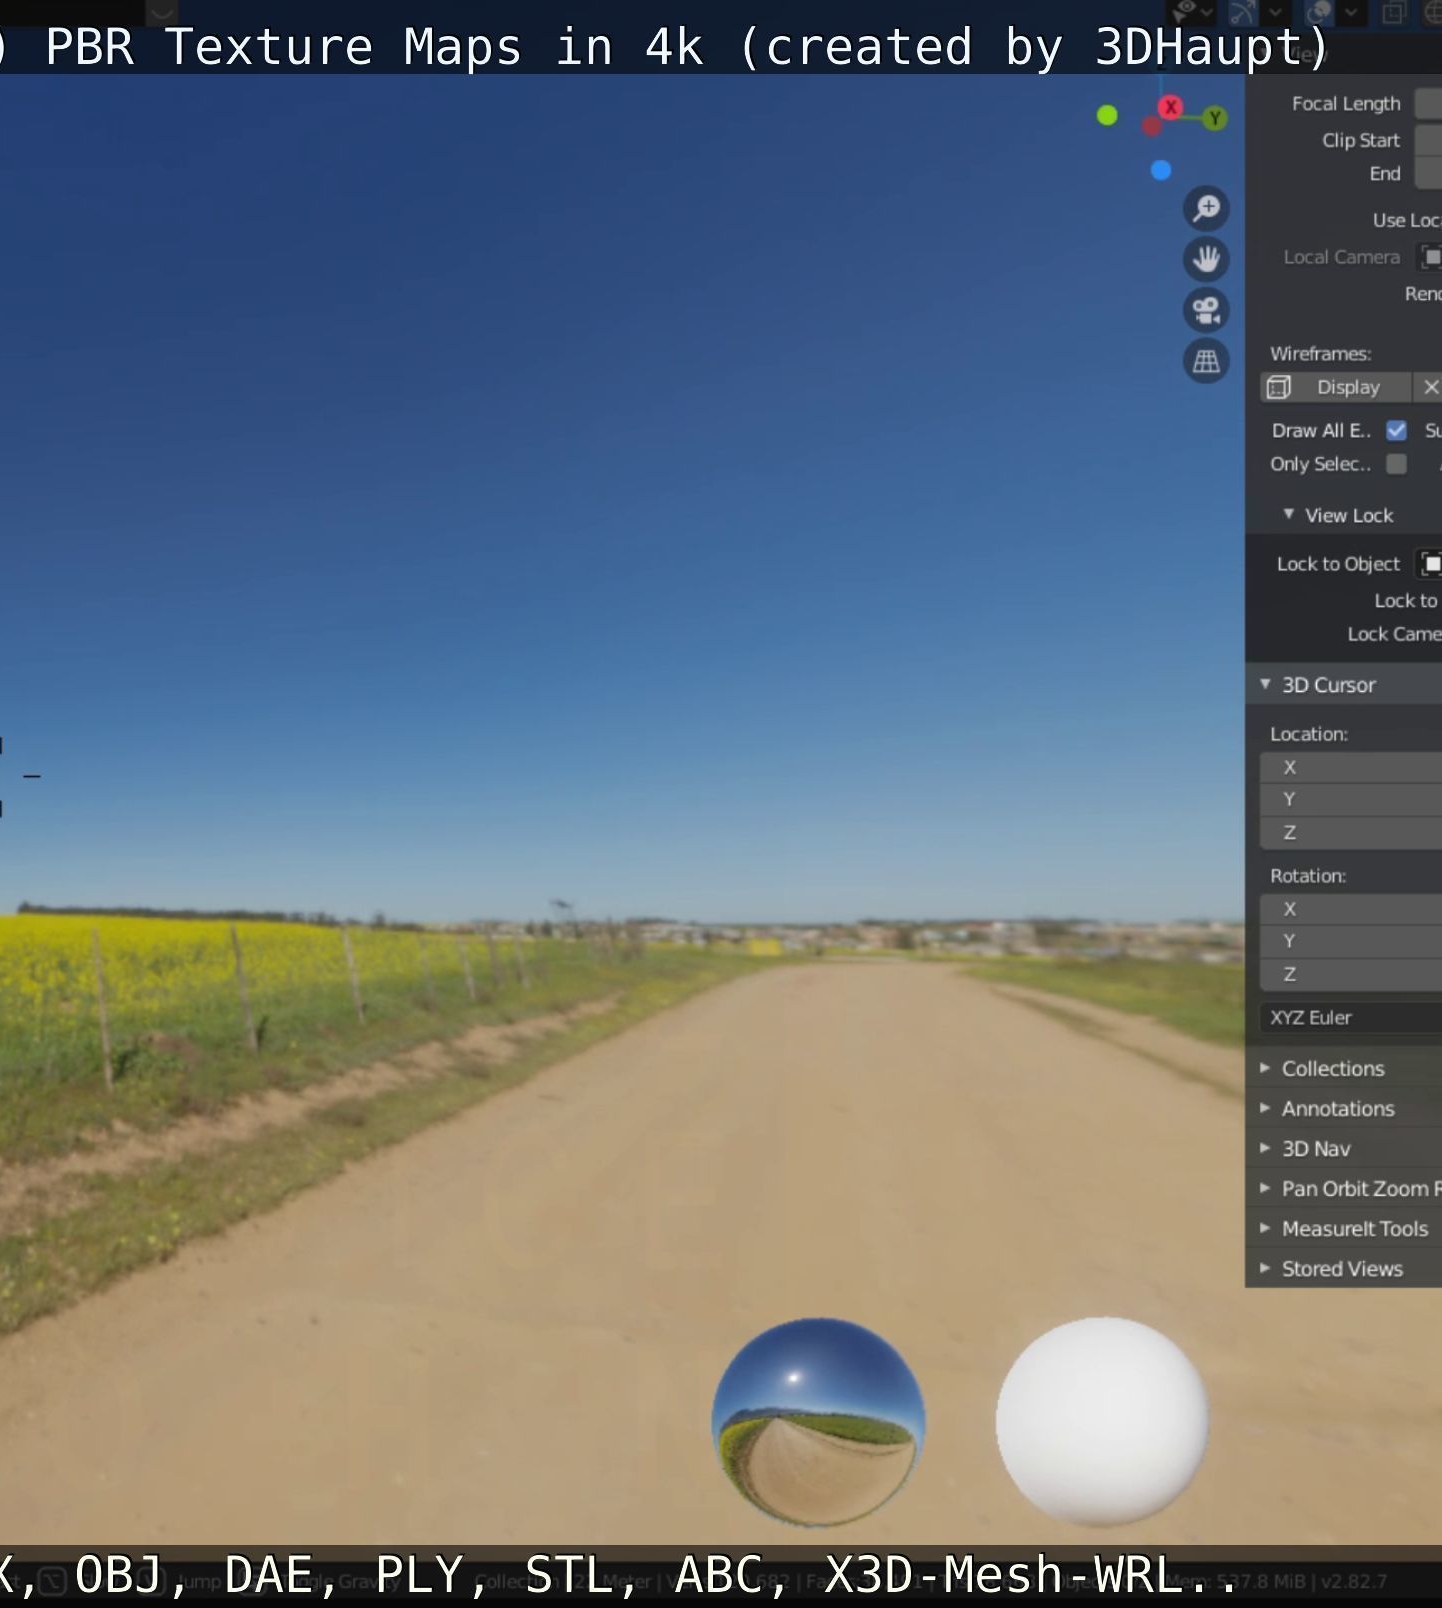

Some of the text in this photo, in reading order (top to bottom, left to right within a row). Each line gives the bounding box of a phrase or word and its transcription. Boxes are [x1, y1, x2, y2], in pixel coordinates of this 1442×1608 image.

[1293, 95, 1401, 115] Focal Length
[1322, 132, 1401, 152] Clip Start
[1370, 165, 1401, 181] End
[1373, 212, 1442, 228] Use Loc
[1284, 248, 1401, 265] Local Camera
[1270, 344, 1371, 362] Wireframes:
[1318, 379, 1381, 399] Display
[1272, 422, 1317, 438] Draw
[1321, 422, 1344, 438] All
[1270, 455, 1310, 475] Only
[1305, 507, 1394, 524] View Lock
[1278, 556, 1401, 575] Lock to Object
[1375, 592, 1438, 608] Lock to
[1348, 625, 1389, 642] Lock
[1282, 676, 1377, 694] 3D Cursor
[1271, 726, 1348, 742] Location:
[1283, 759, 1297, 775] X
[1283, 791, 1296, 807] Y
[1283, 824, 1297, 840] Z
[1271, 868, 1346, 884] Rotation:
[1283, 901, 1297, 917] X
[1283, 933, 1296, 949] Y
[1283, 966, 1297, 982] Z
[1270, 1009, 1353, 1026] XYZ Euler
[1282, 1060, 1386, 1077] Collections
[1281, 1100, 1396, 1118] Annotations
[1283, 1140, 1351, 1158] 3D Nav
[1282, 1180, 1318, 1197] Pan
[1322, 1179, 1370, 1197] Orbit
[1372, 1180, 1430, 1197] Zoom
[1379, 1220, 1429, 1237] Tools
[1282, 1260, 1404, 1278] Stored Views
[1216, 1573, 1269, 1589] 537.8
[1274, 1573, 1307, 1589] MiB
[1321, 1573, 1388, 1589] v2.82.7
